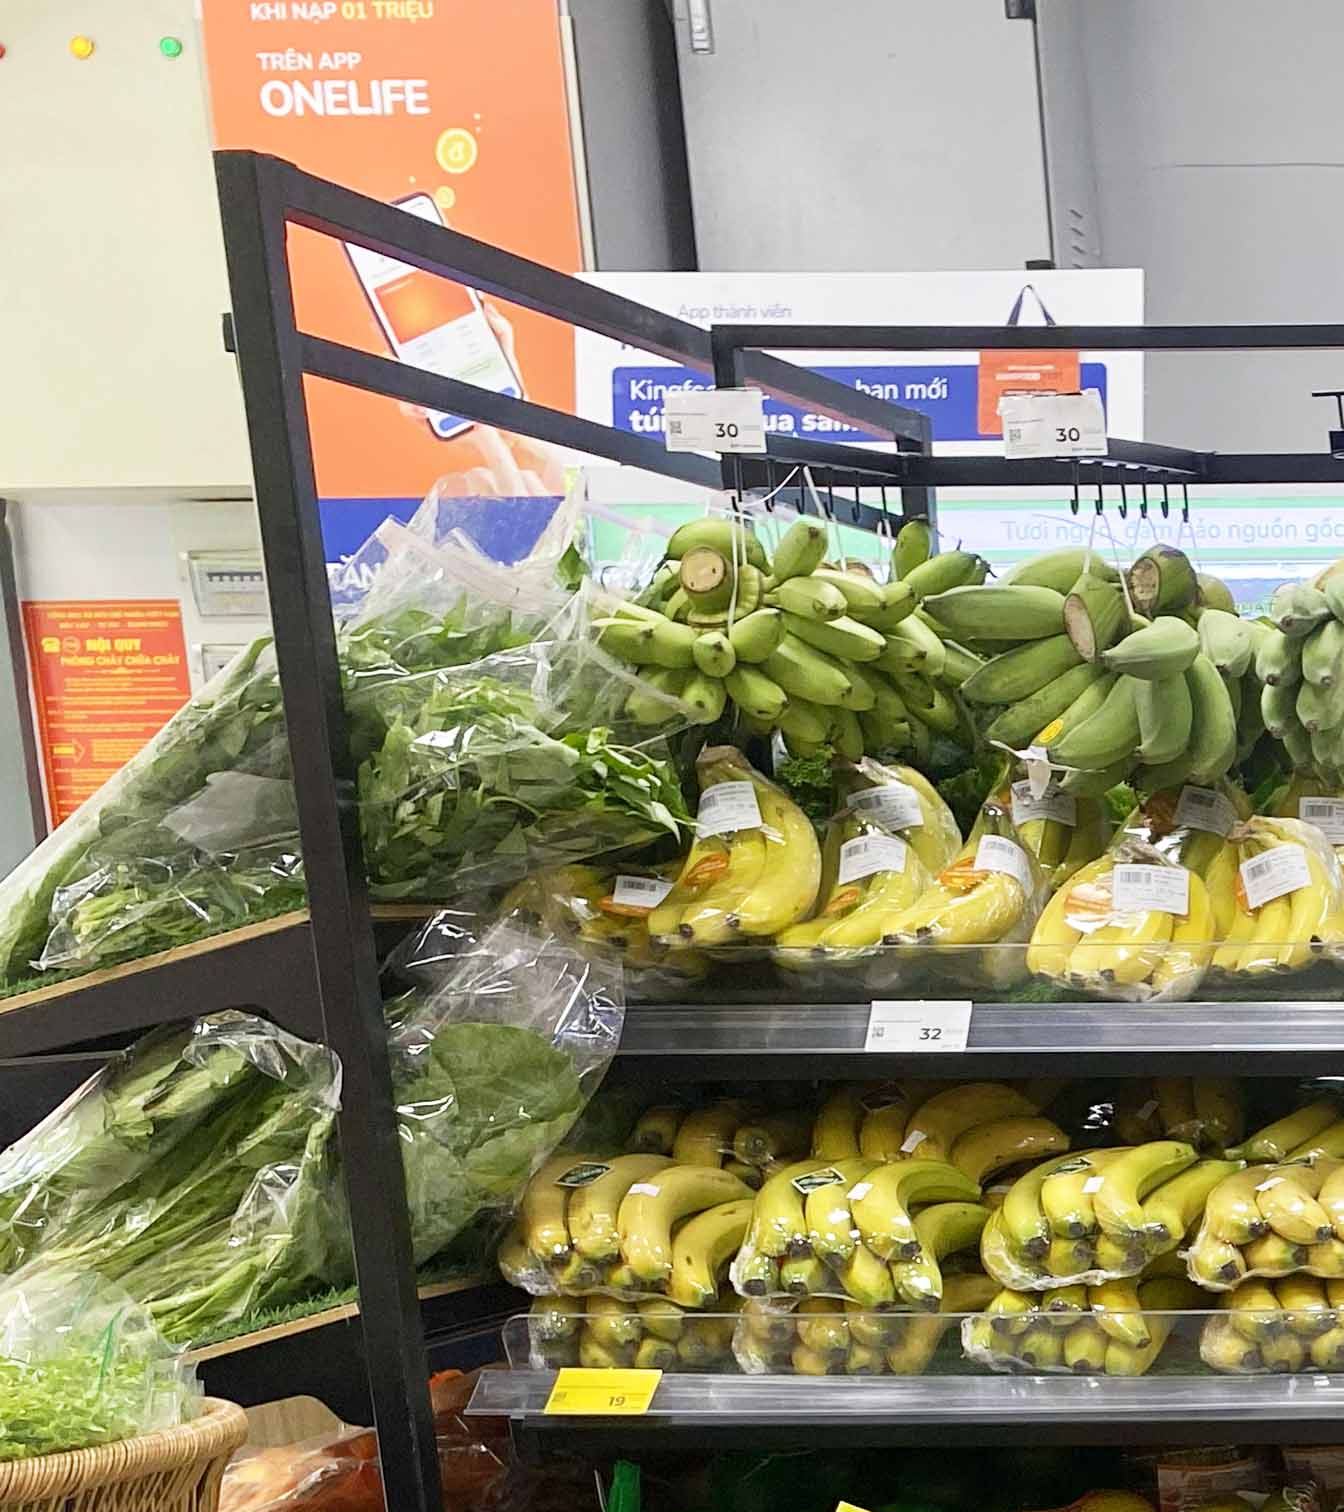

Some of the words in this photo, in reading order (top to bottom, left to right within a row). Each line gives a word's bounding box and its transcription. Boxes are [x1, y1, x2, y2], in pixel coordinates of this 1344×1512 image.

[251, 2, 286, 20] KHI
[342, 2, 367, 19] 01
[256, 48, 313, 71] TRÊN
[319, 52, 362, 71] APP
[259, 79, 431, 116] ONELIFE
[678, 304, 710, 320] App
[905, 378, 948, 400] mới
[715, 424, 739, 438] 30
[1056, 427, 1080, 442] 30
[919, 1027, 942, 1040] 32
[608, 1396, 626, 1406] 19
